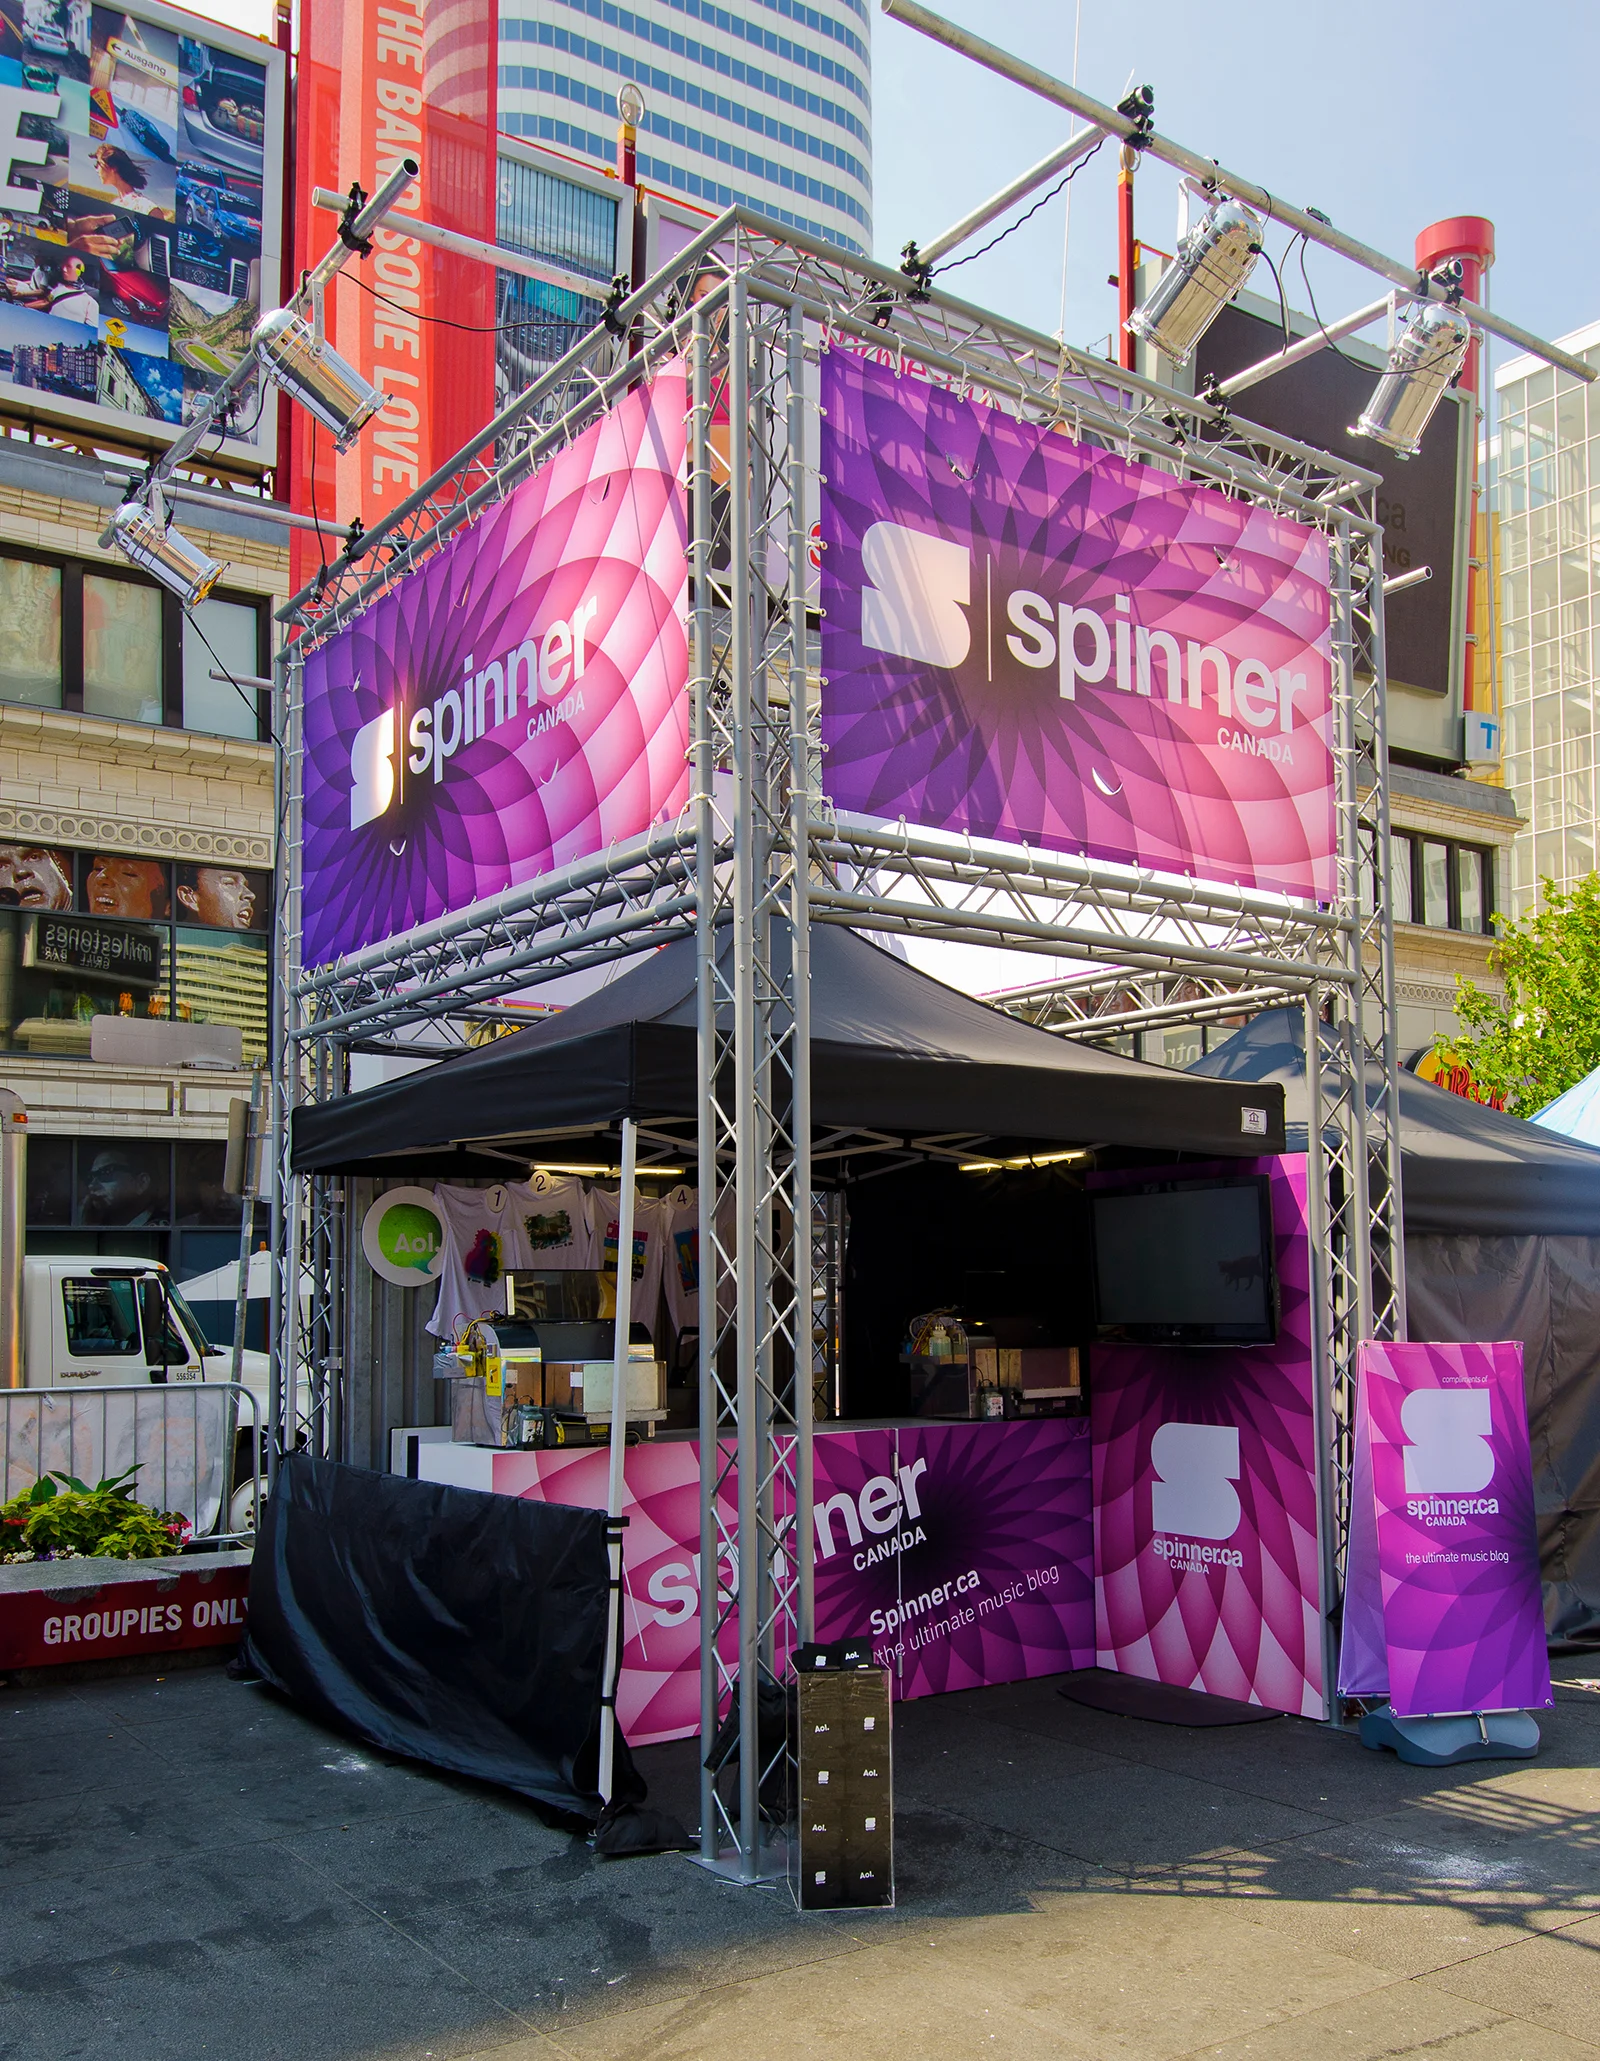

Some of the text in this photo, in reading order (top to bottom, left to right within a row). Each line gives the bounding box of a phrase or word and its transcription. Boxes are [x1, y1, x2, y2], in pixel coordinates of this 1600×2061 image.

[124, 48, 167, 77] Ausgang
[372, 365, 420, 495] LOVE.
[1006, 589, 1307, 734] spinner
[408, 595, 598, 785] spinner
[526, 691, 585, 741] CANADA
[1217, 728, 1294, 766] CANADA
[535, 1175, 546, 1192] 2
[495, 1190, 502, 1207] 1
[676, 1189, 687, 1205] 4
[176, 1372, 196, 1381] 556354
[1442, 1374, 1489, 1384] compliments of
[1407, 1495, 1499, 1520] spinner.ca
[1426, 1515, 1467, 1527] CANADA
[853, 1526, 928, 1572] CANADA
[1153, 1537, 1244, 1568] spinner.ca
[1405, 1550, 1509, 1564] the ultimate music blog
[1170, 1558, 1210, 1575] CANADA
[870, 1569, 981, 1635] Spinner.ca
[876, 1565, 1060, 1665] the ultimate music blog
[43, 1604, 183, 1645] GROUPIES
[845, 1651, 860, 1660] Aol.
[814, 1723, 830, 1733] Aol.
[863, 1769, 878, 1777] Aol.
[812, 1824, 827, 1832] Aol.
[860, 1871, 875, 1879] Aol.
